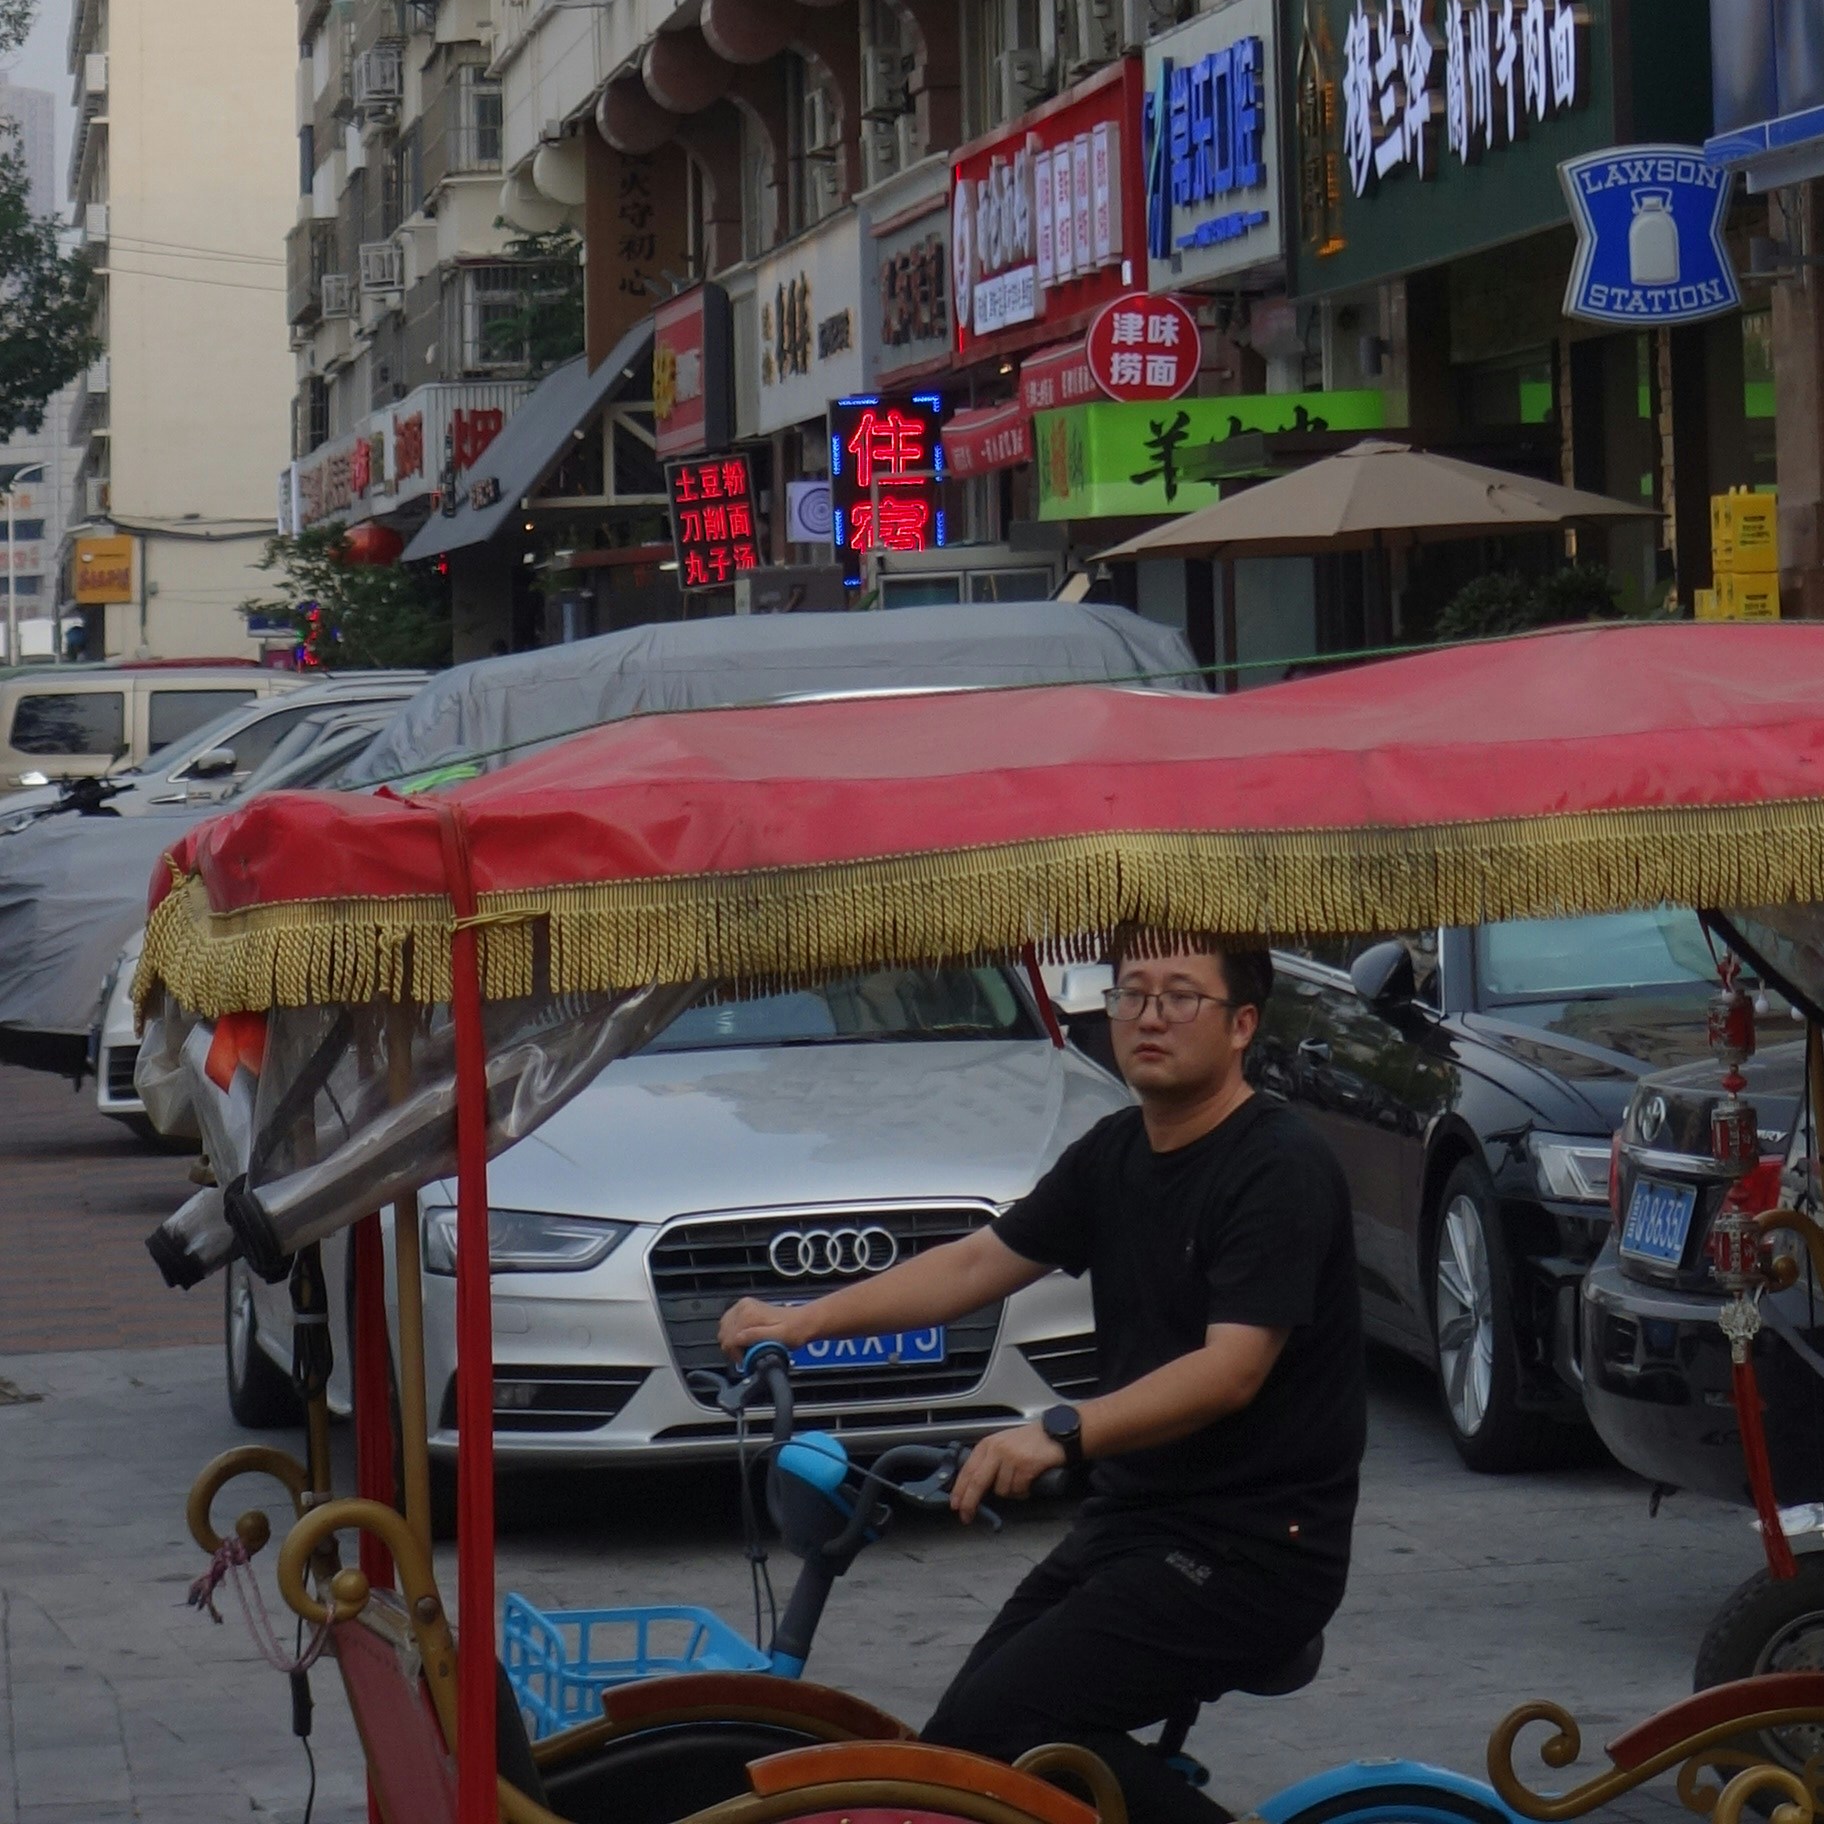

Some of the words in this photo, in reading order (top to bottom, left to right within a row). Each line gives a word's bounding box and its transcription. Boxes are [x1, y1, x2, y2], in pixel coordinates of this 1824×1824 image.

[1580, 158, 1722, 195] LAWSON
[1588, 277, 1726, 313] STATION
[1110, 312, 1181, 347] 津味
[1109, 352, 1179, 388] 捞面
[675, 459, 746, 503] 土豆粉
[680, 503, 752, 543] 刀削面
[684, 542, 757, 586] 丸子汤
